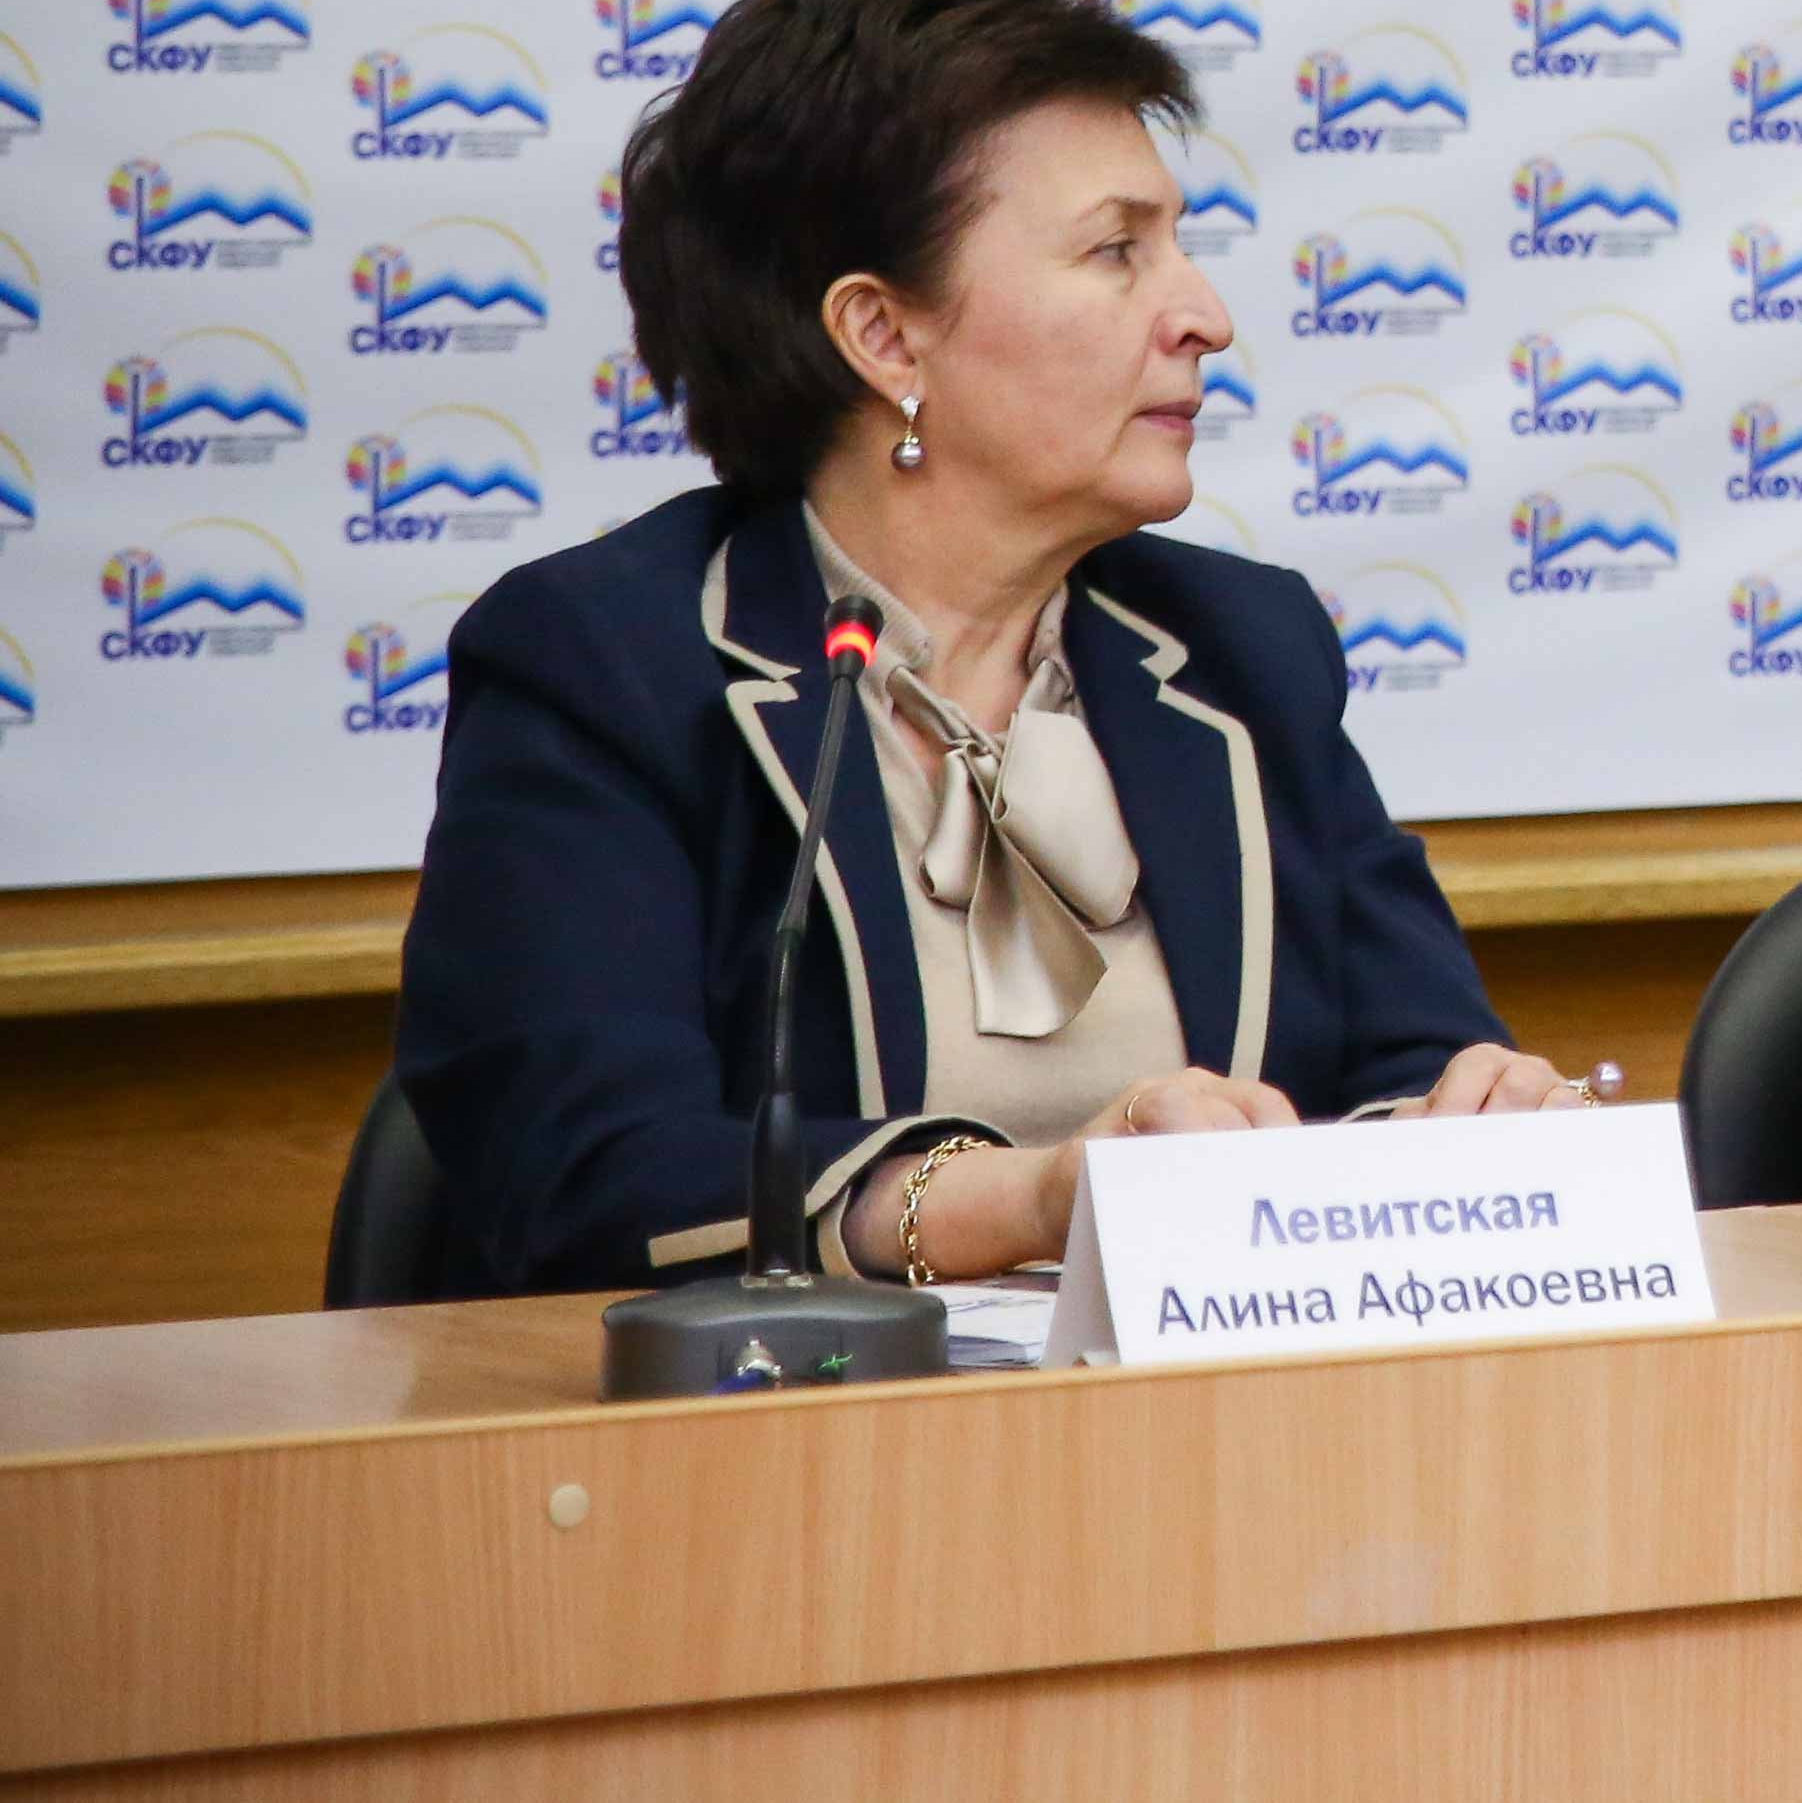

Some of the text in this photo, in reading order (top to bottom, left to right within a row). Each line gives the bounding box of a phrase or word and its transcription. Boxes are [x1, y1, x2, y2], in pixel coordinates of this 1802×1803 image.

[107, 43, 210, 74] СКФУ
[352, 132, 451, 161] СКФУ
[107, 239, 210, 270] СКФУ
[350, 326, 449, 355] СКФУ
[104, 438, 207, 468] СКФУ
[344, 514, 443, 543] СКФУ
[100, 632, 204, 661] СКФУ
[344, 704, 443, 732] СКФУ
[1250, 1189, 1558, 1248] Левитская
[1157, 1261, 1677, 1336] Алина Афакоевна
